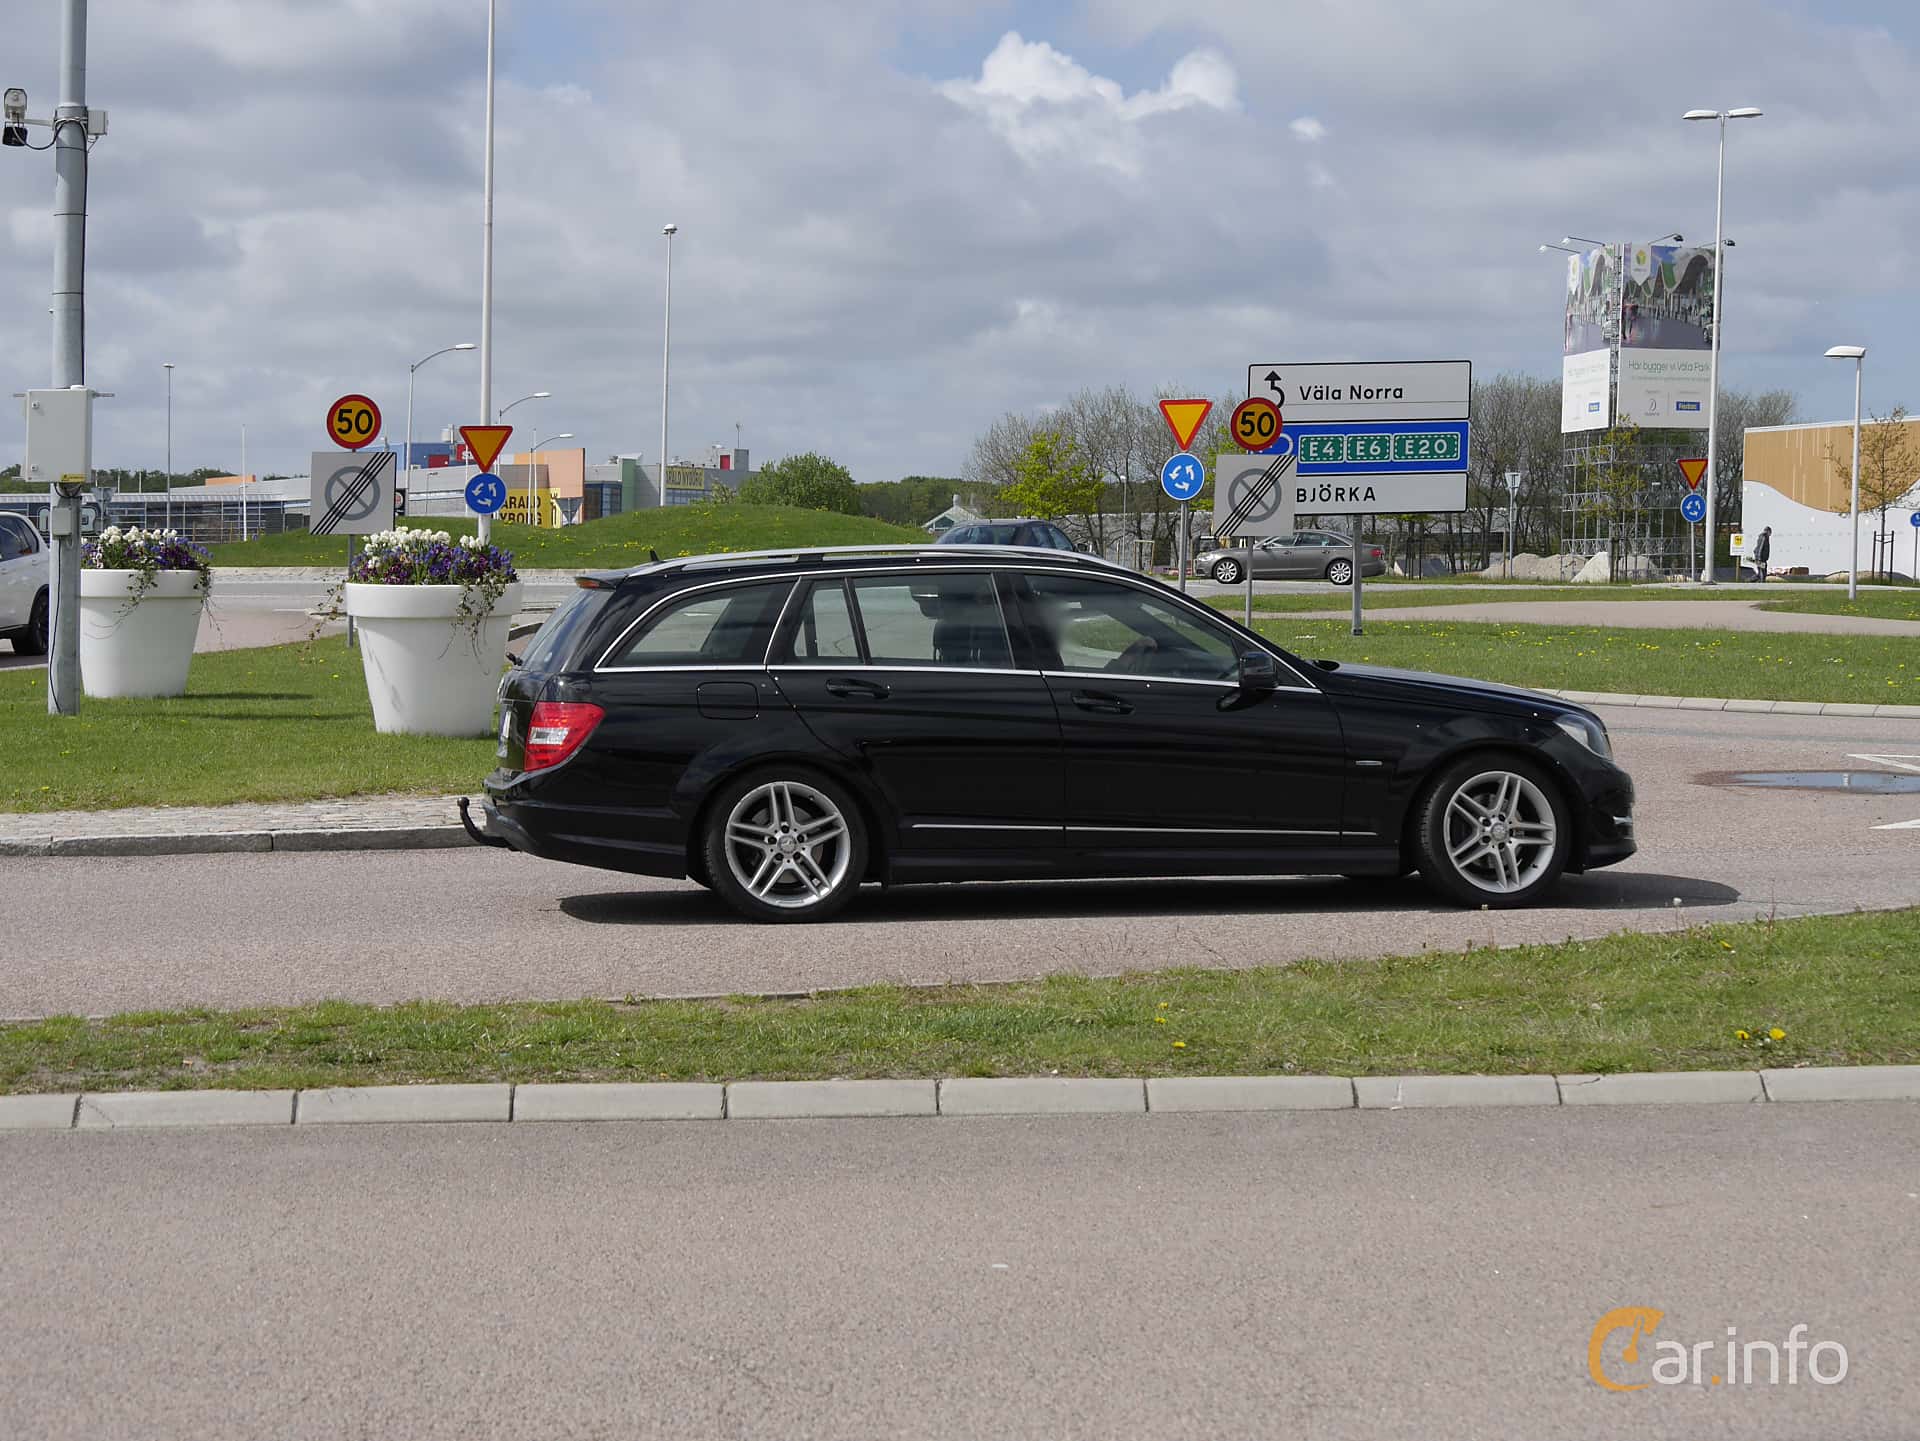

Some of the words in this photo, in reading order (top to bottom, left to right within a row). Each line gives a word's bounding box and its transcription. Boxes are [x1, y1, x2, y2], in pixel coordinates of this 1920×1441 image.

[1299, 385, 1342, 400] Väla
[1349, 384, 1403, 400] Norra
[337, 408, 374, 435] 50
[1240, 411, 1275, 437] 50
[1308, 441, 1335, 457] E4
[1356, 440, 1381, 456] E6
[1404, 438, 1448, 455] E20
[1296, 483, 1376, 502] BJÖRKA
[501, 495, 542, 510] ARALD
